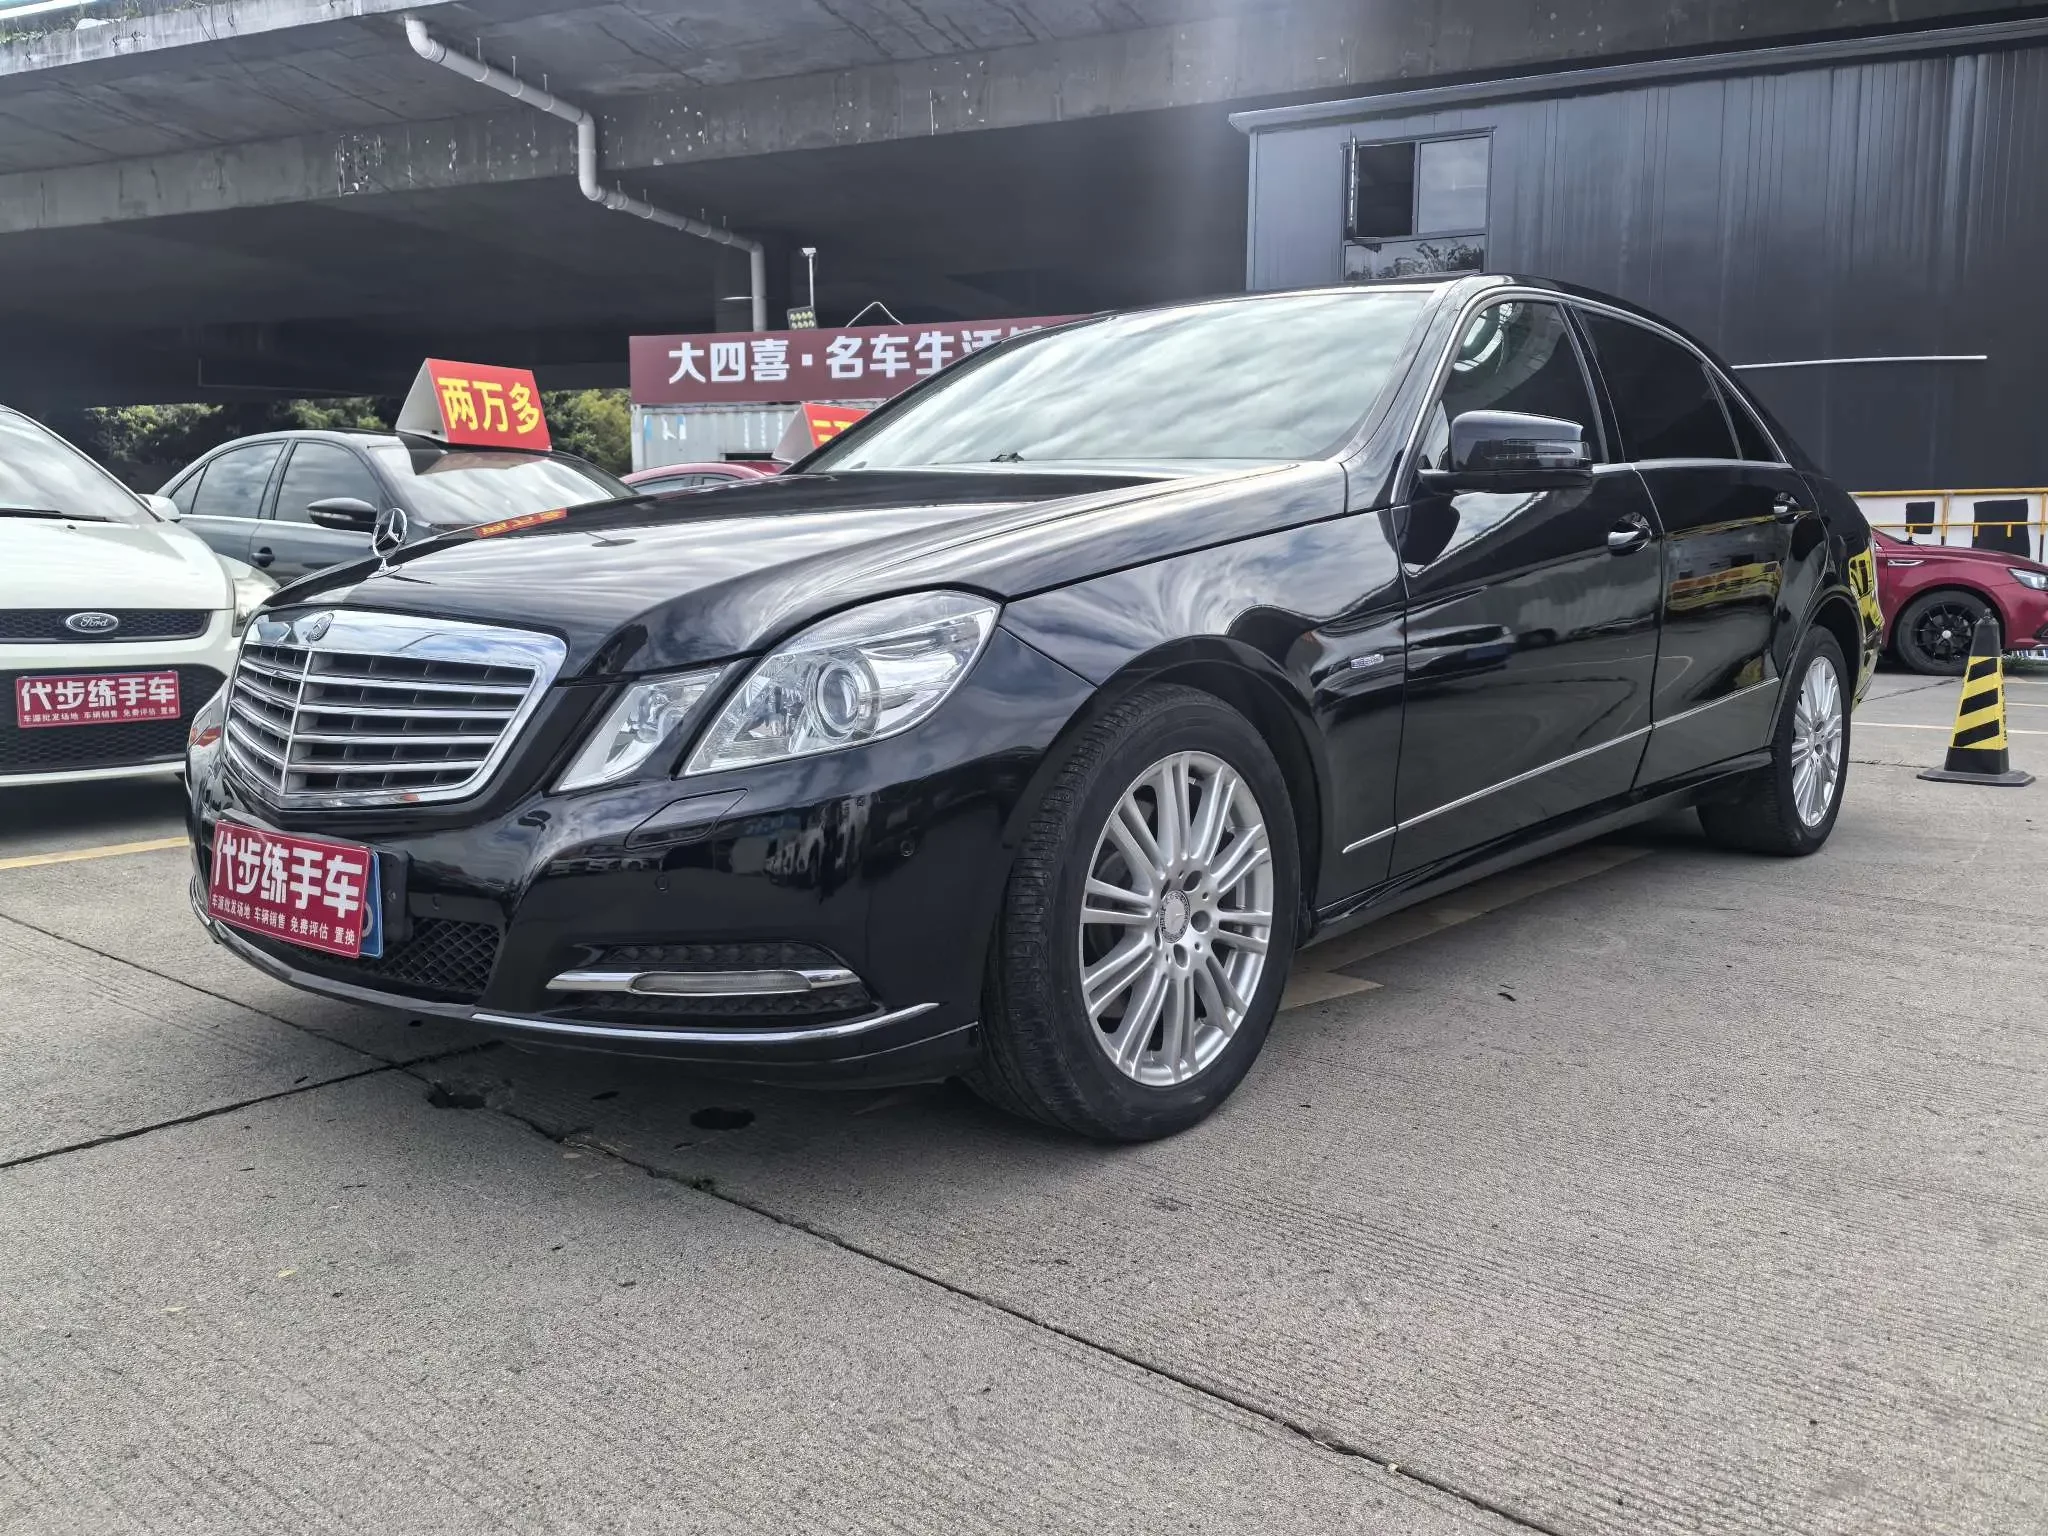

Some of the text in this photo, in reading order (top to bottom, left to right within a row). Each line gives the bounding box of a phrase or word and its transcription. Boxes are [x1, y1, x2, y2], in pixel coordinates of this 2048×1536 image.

[437, 377, 540, 434] 两万多
[80, 615, 108, 627] Ford
[21, 676, 176, 711] 代步练手车
[215, 830, 363, 918] 代步练手车
[212, 893, 355, 946] 车源批发场地 车辆销售 免费评估 置换
